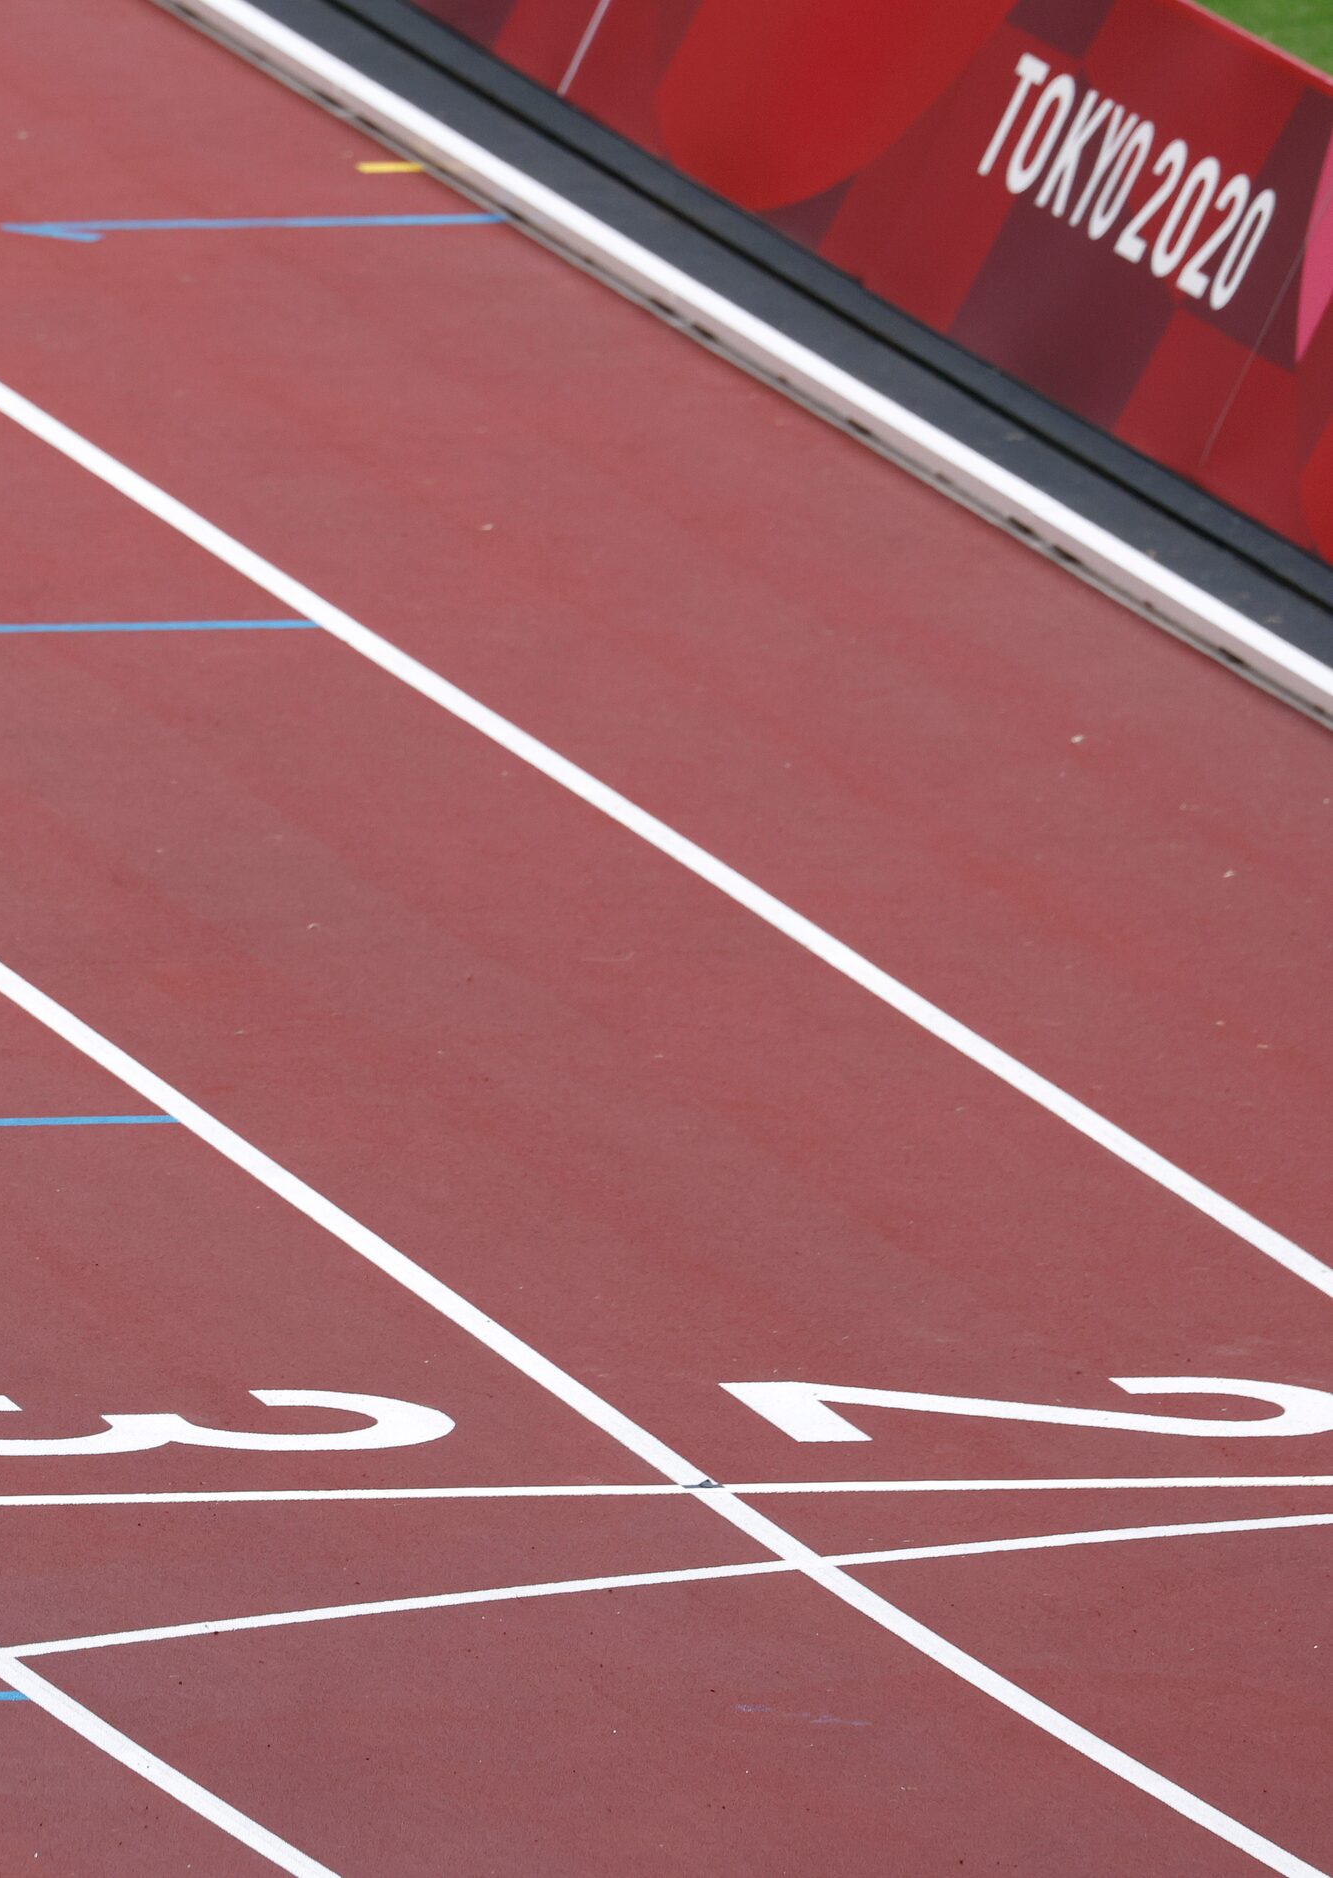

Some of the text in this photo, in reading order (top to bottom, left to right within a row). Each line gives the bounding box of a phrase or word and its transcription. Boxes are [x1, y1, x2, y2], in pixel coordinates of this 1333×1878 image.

[977, 52, 1277, 311] TOKYO 2020
[718, 1376, 1333, 1443] 2
